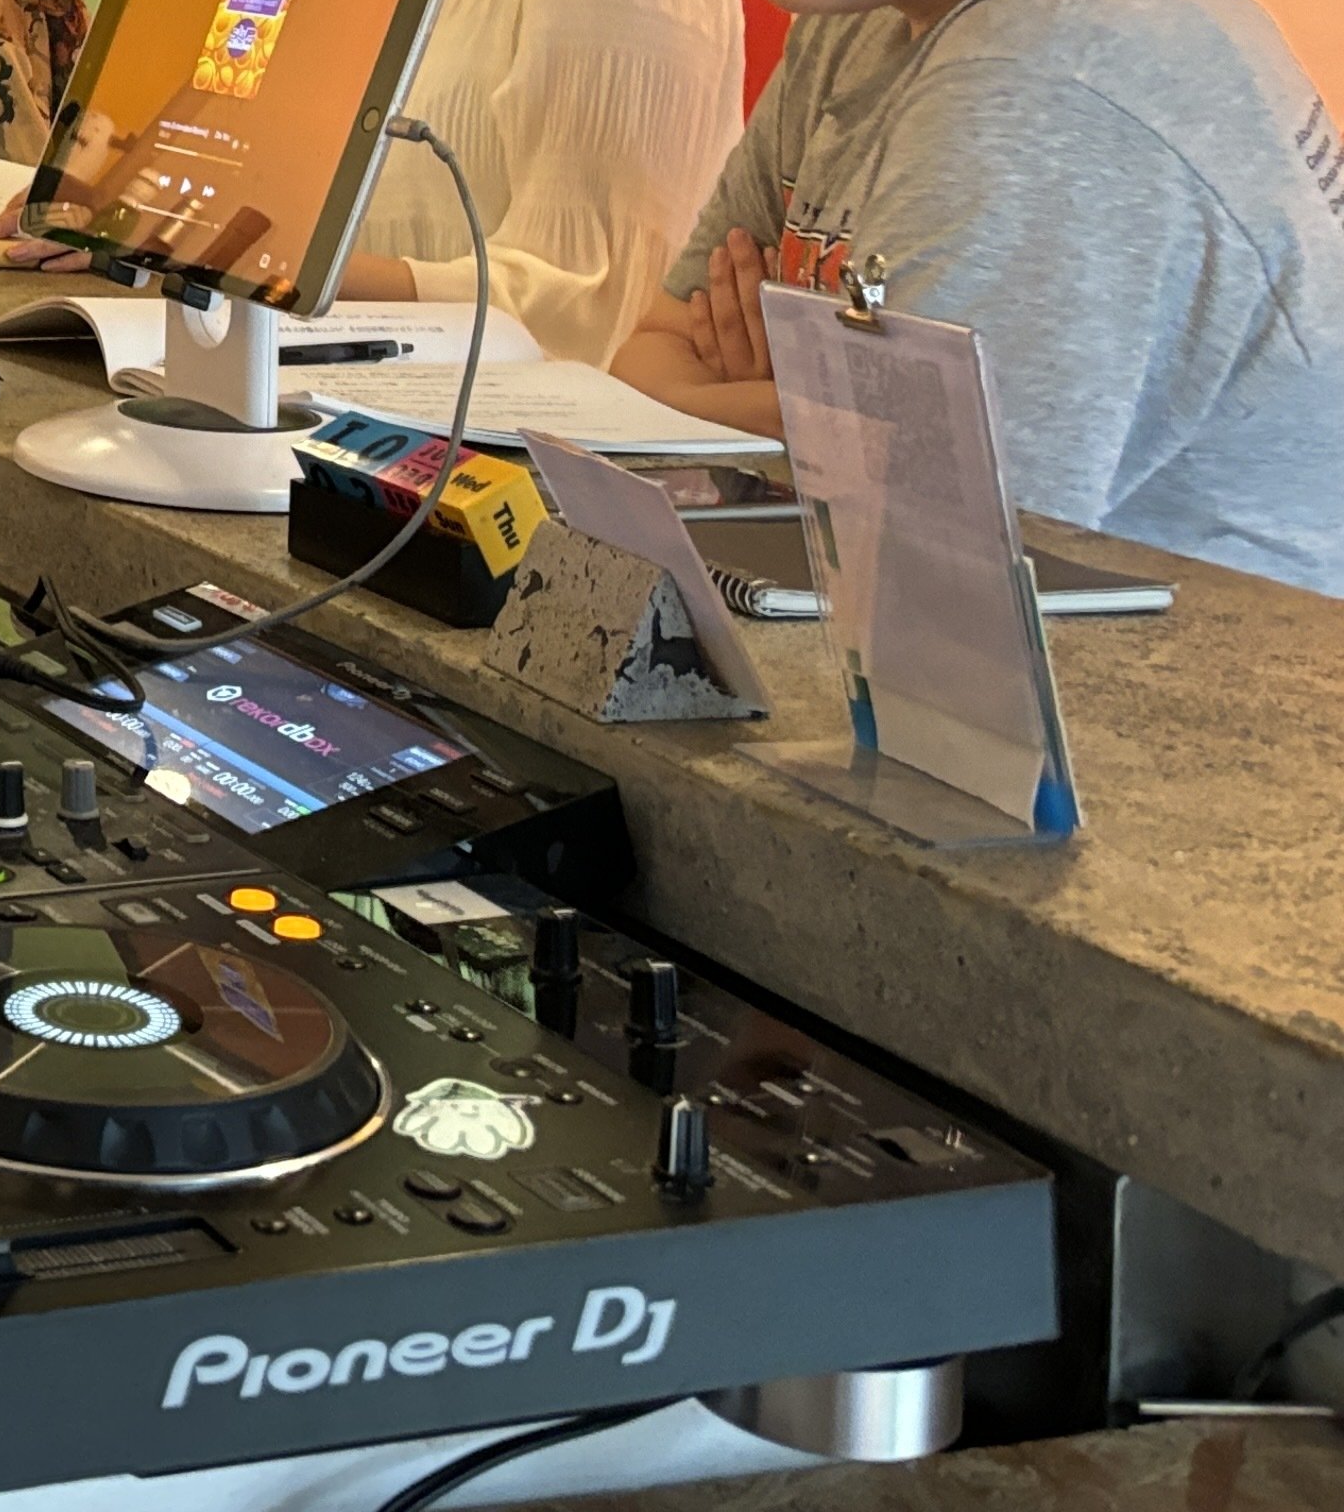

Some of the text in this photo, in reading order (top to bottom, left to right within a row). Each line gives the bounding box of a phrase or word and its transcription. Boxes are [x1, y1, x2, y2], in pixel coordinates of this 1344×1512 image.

[451, 471, 493, 494] Wed
[492, 500, 521, 551] Thu
[228, 692, 343, 760] rekordbox
[161, 1284, 677, 1410] Pioneer DJ
